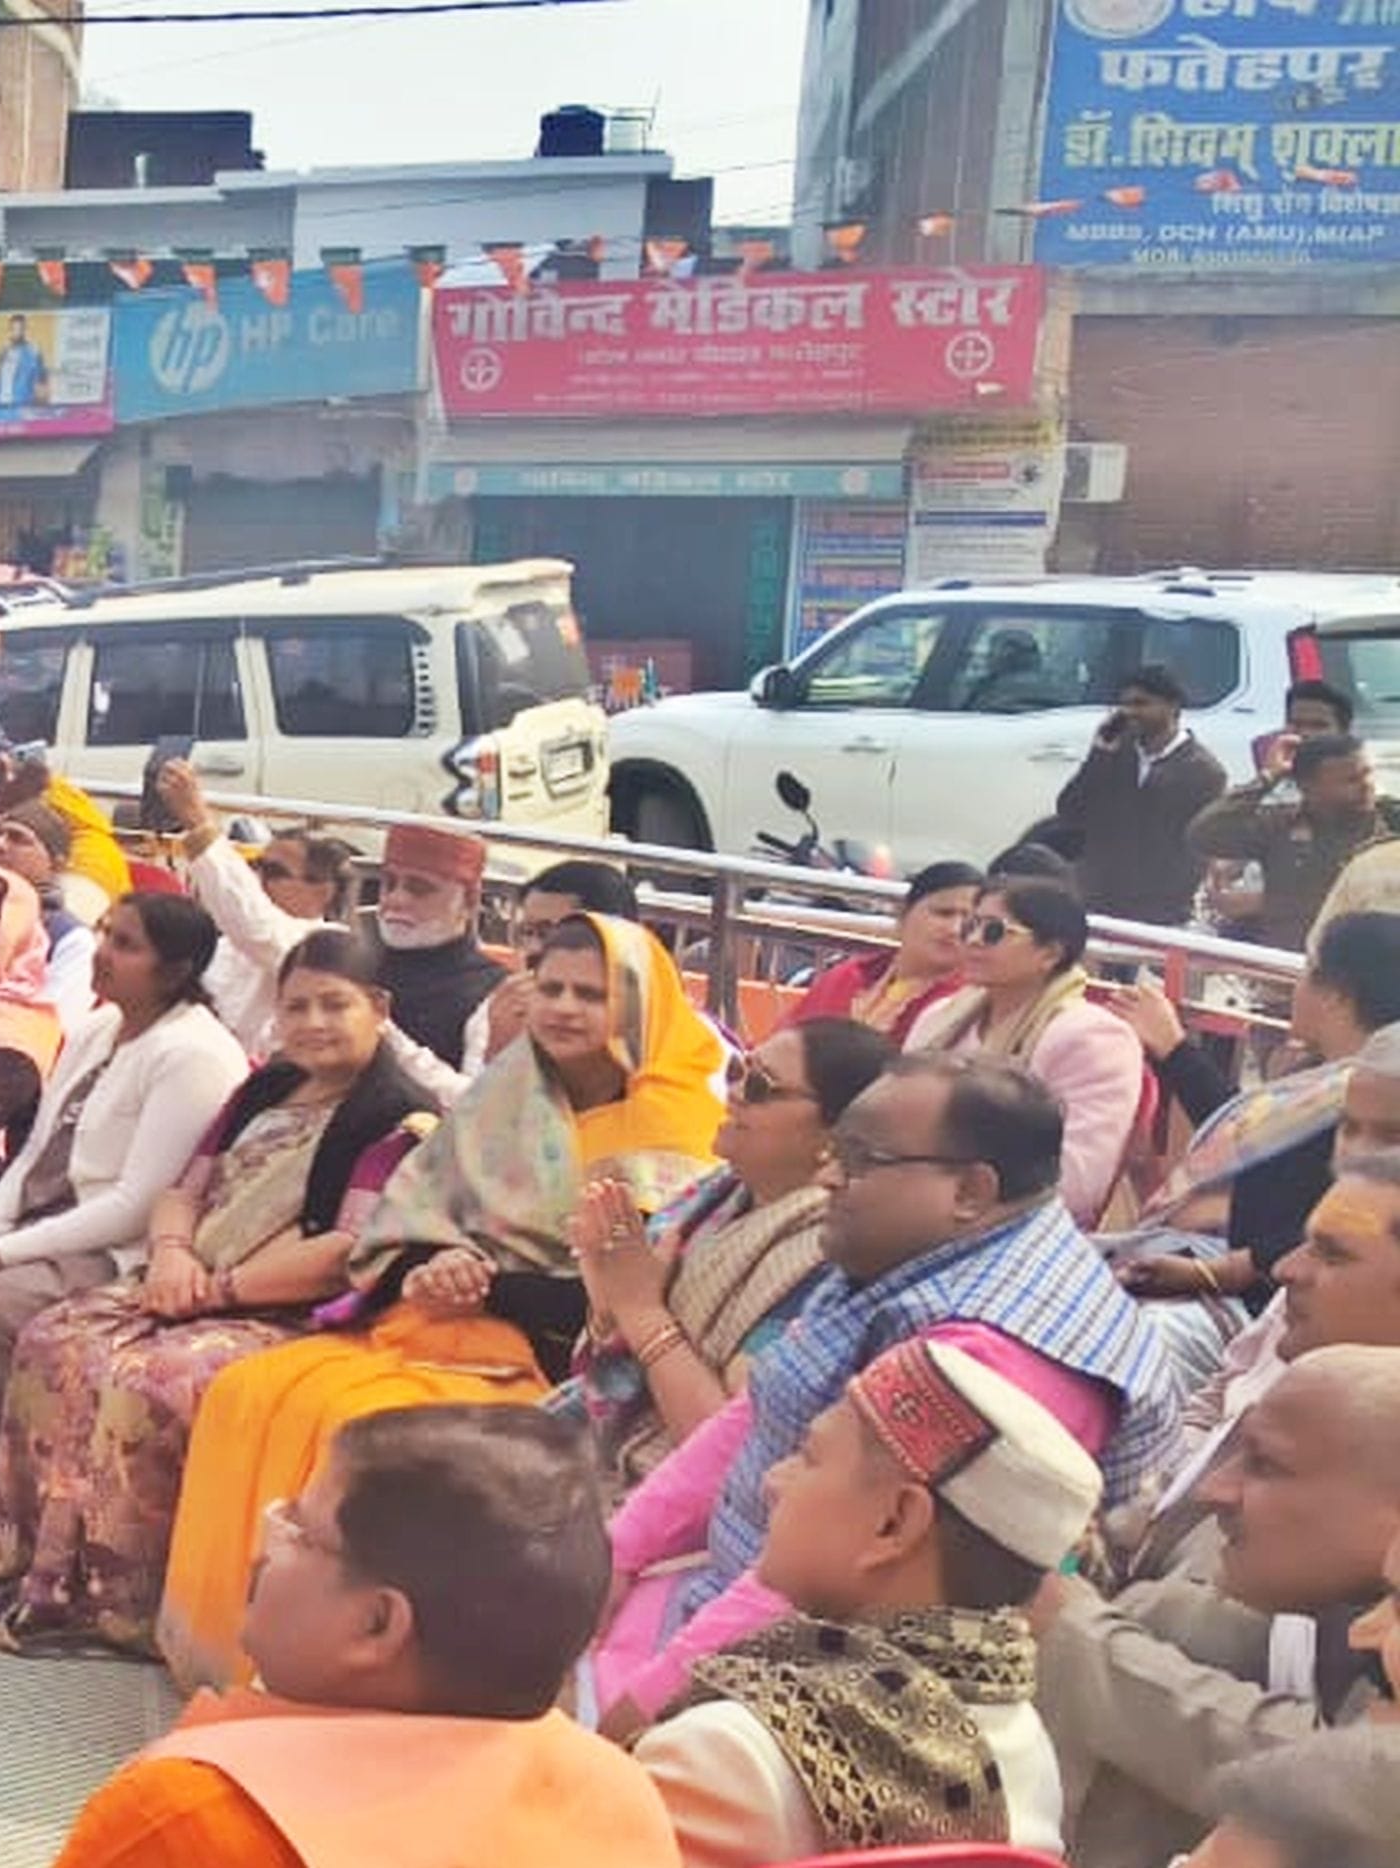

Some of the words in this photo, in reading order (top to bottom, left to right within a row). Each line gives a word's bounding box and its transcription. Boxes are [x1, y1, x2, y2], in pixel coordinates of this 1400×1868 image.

[890, 266, 1020, 328] स्टोर
[241, 312, 292, 350] HP
[309, 306, 398, 344] Care
